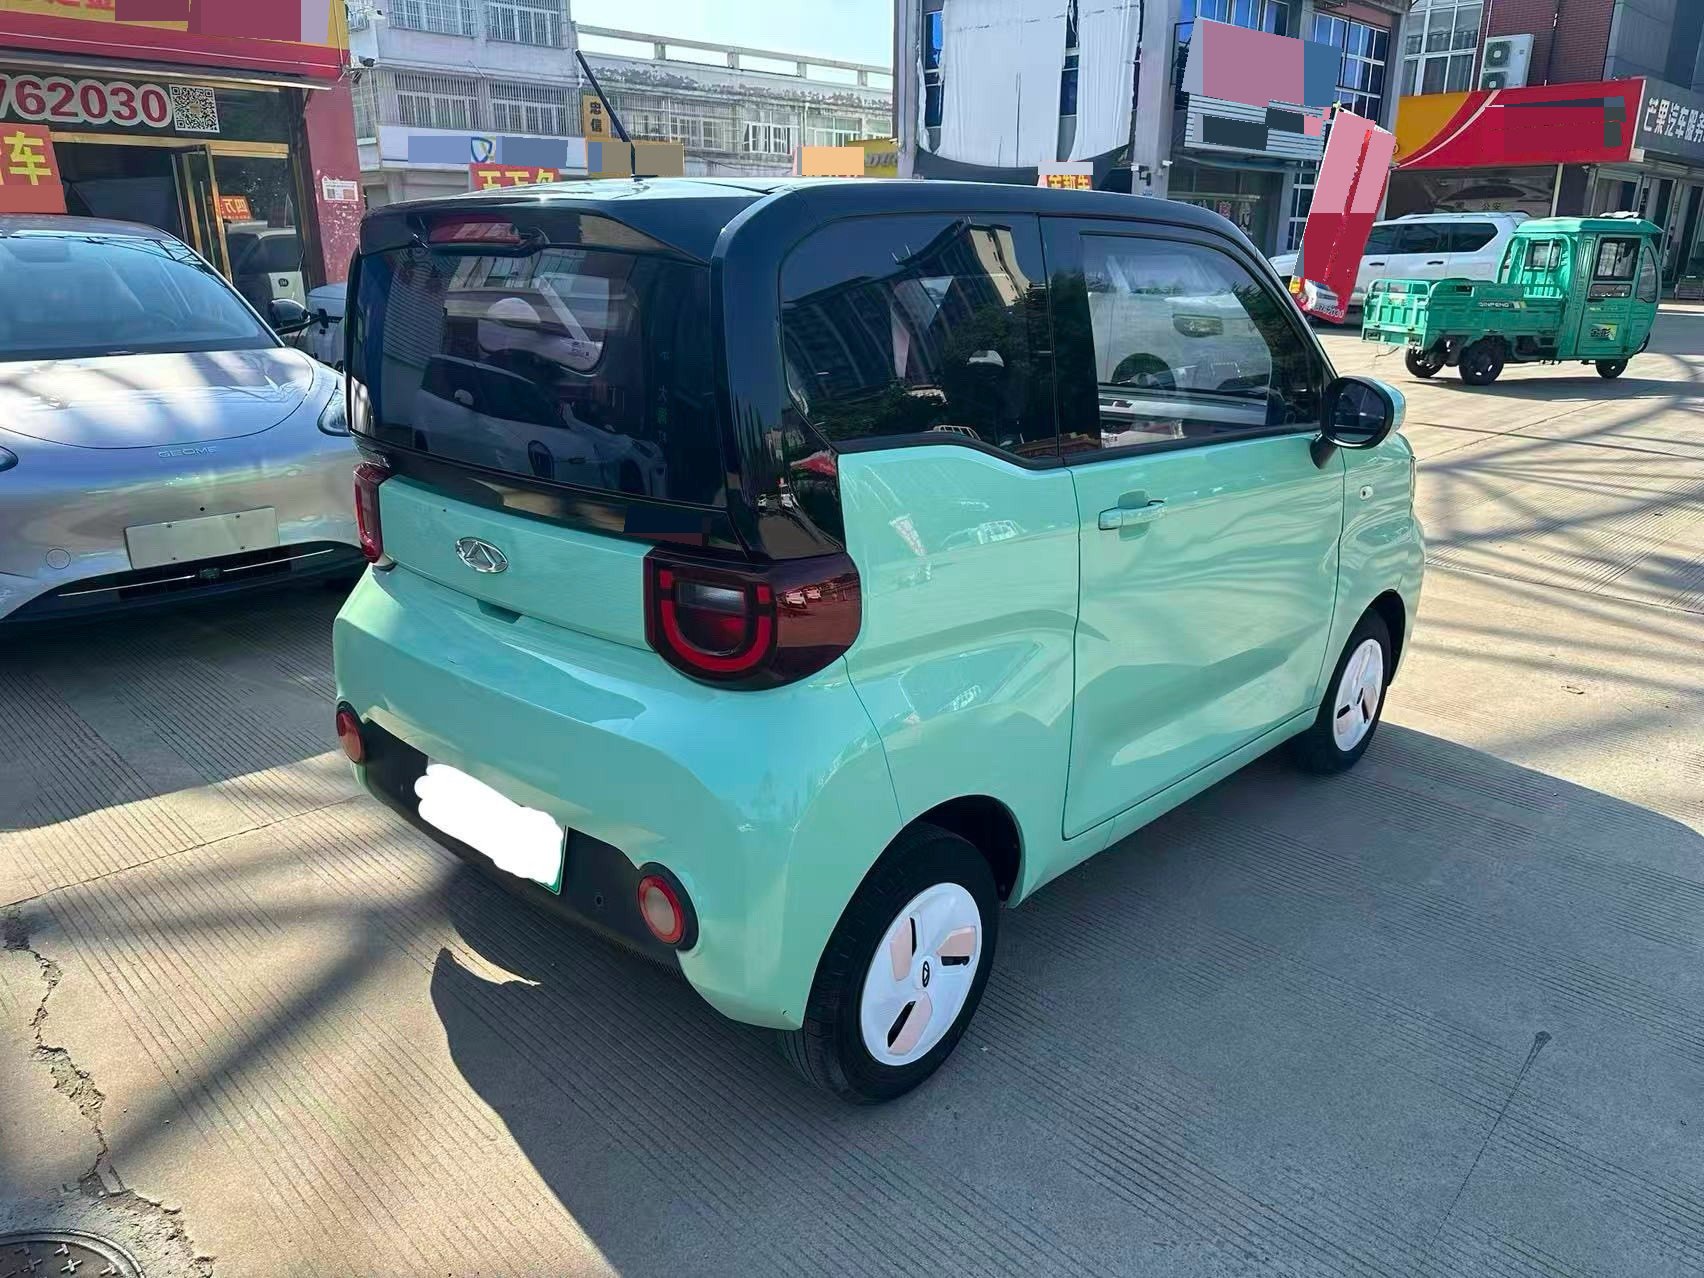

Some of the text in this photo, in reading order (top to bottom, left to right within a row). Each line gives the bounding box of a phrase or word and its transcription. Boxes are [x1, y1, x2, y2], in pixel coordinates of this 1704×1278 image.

[0, 75, 172, 127] 62030
[1643, 97, 1704, 143] 芒果汽车服务
[0, 131, 52, 186] 车
